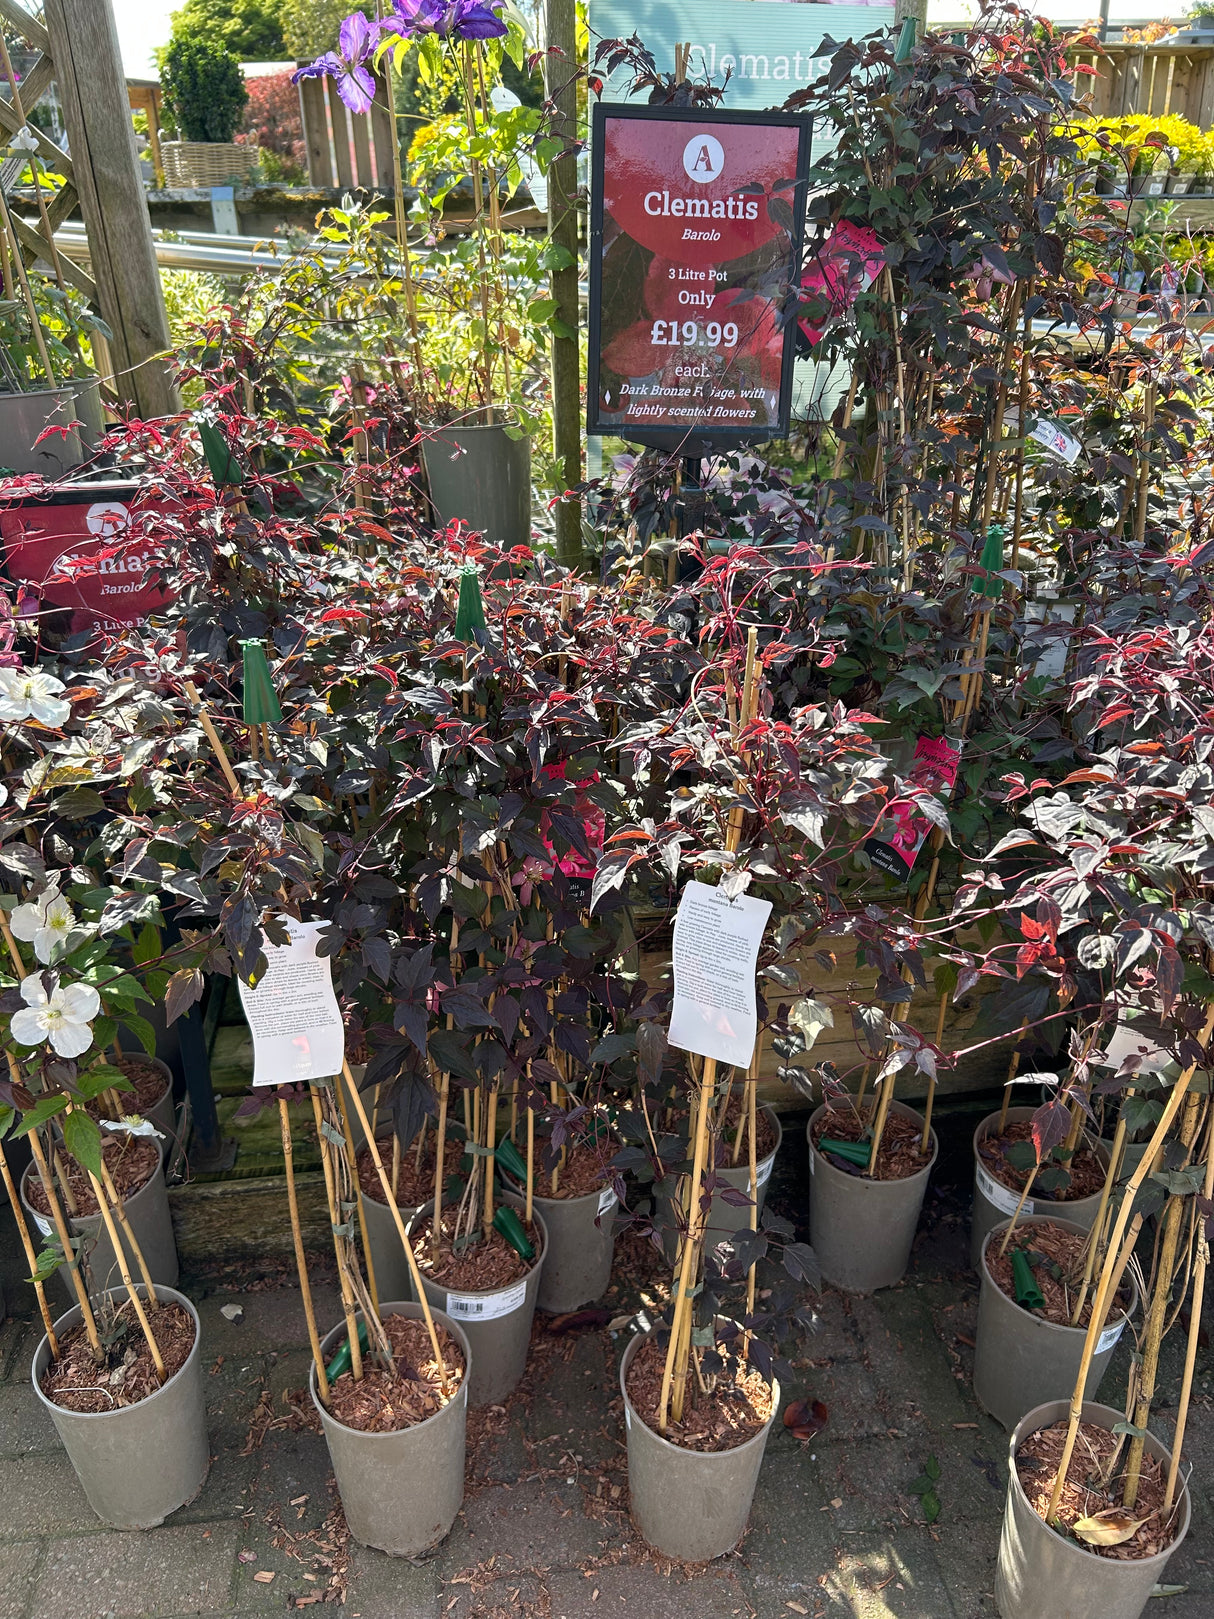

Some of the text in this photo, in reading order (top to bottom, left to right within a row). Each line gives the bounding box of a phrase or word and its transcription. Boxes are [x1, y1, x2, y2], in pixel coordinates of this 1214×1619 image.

[686, 43, 832, 81] Clematis
[692, 145, 714, 171] A
[644, 190, 758, 220] Clematis
[682, 229, 721, 241] Barolo
[668, 268, 728, 282] 3 Litre Pot
[678, 290, 716, 309] Only
[651, 319, 739, 347] £19.99
[619, 384, 649, 396] Dark
[650, 385, 691, 397] Bronze
[740, 388, 766, 399] with
[627, 404, 666, 418] lightly
[713, 405, 757, 419] flowers
[93, 621, 101, 631] 3
